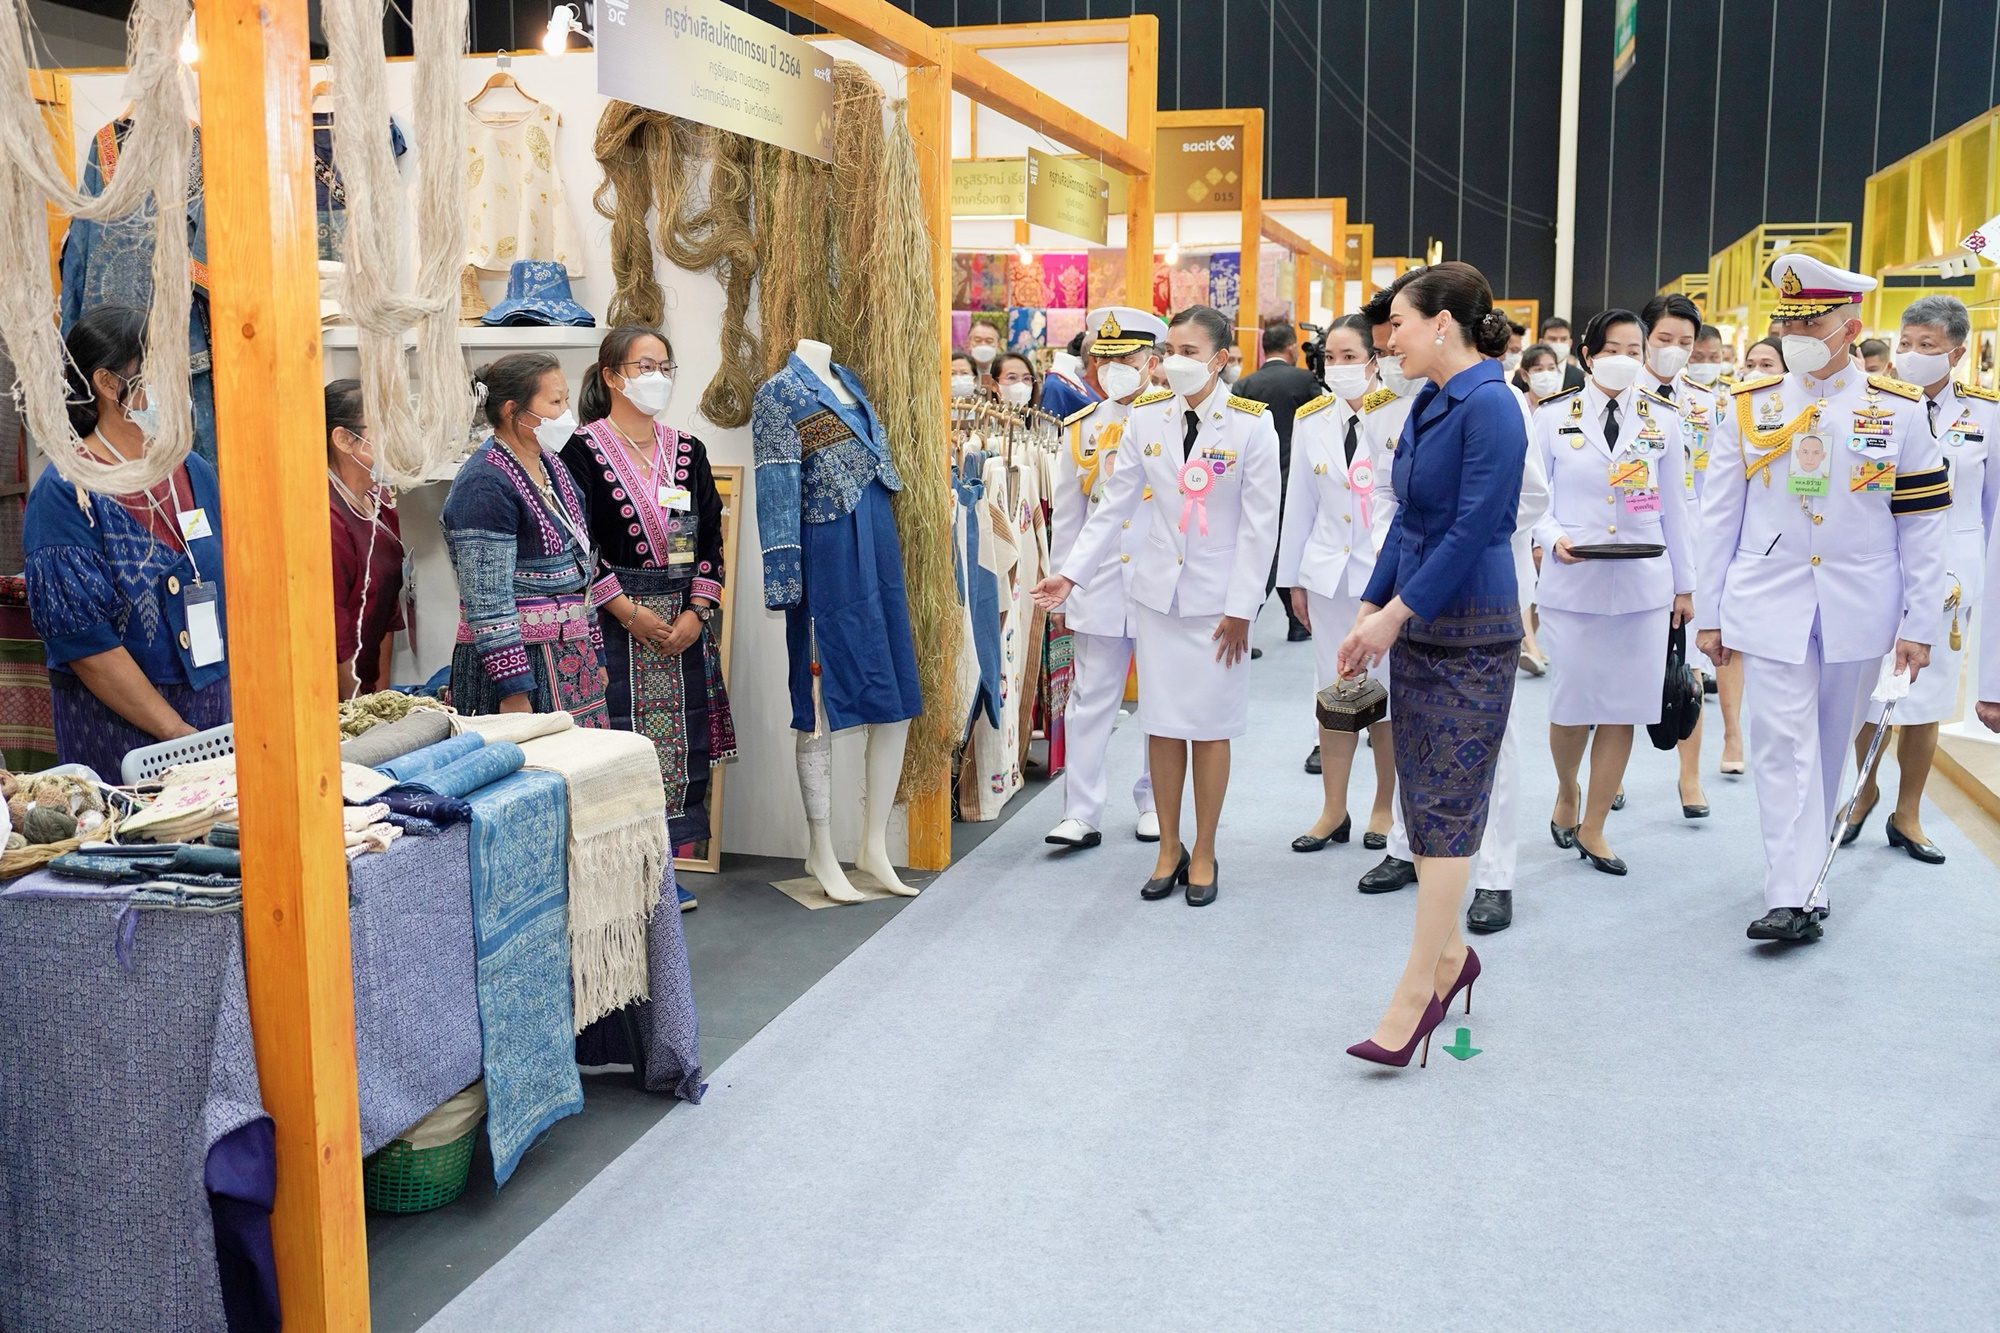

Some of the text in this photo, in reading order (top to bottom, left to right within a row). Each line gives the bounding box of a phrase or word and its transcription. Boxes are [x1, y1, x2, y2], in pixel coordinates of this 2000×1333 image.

[665, 6, 801, 79] ครูช่างศิลปหัตถกรรม ปี 2564
[1182, 140, 1216, 152] sacit
[1214, 192, 1234, 202] D15
